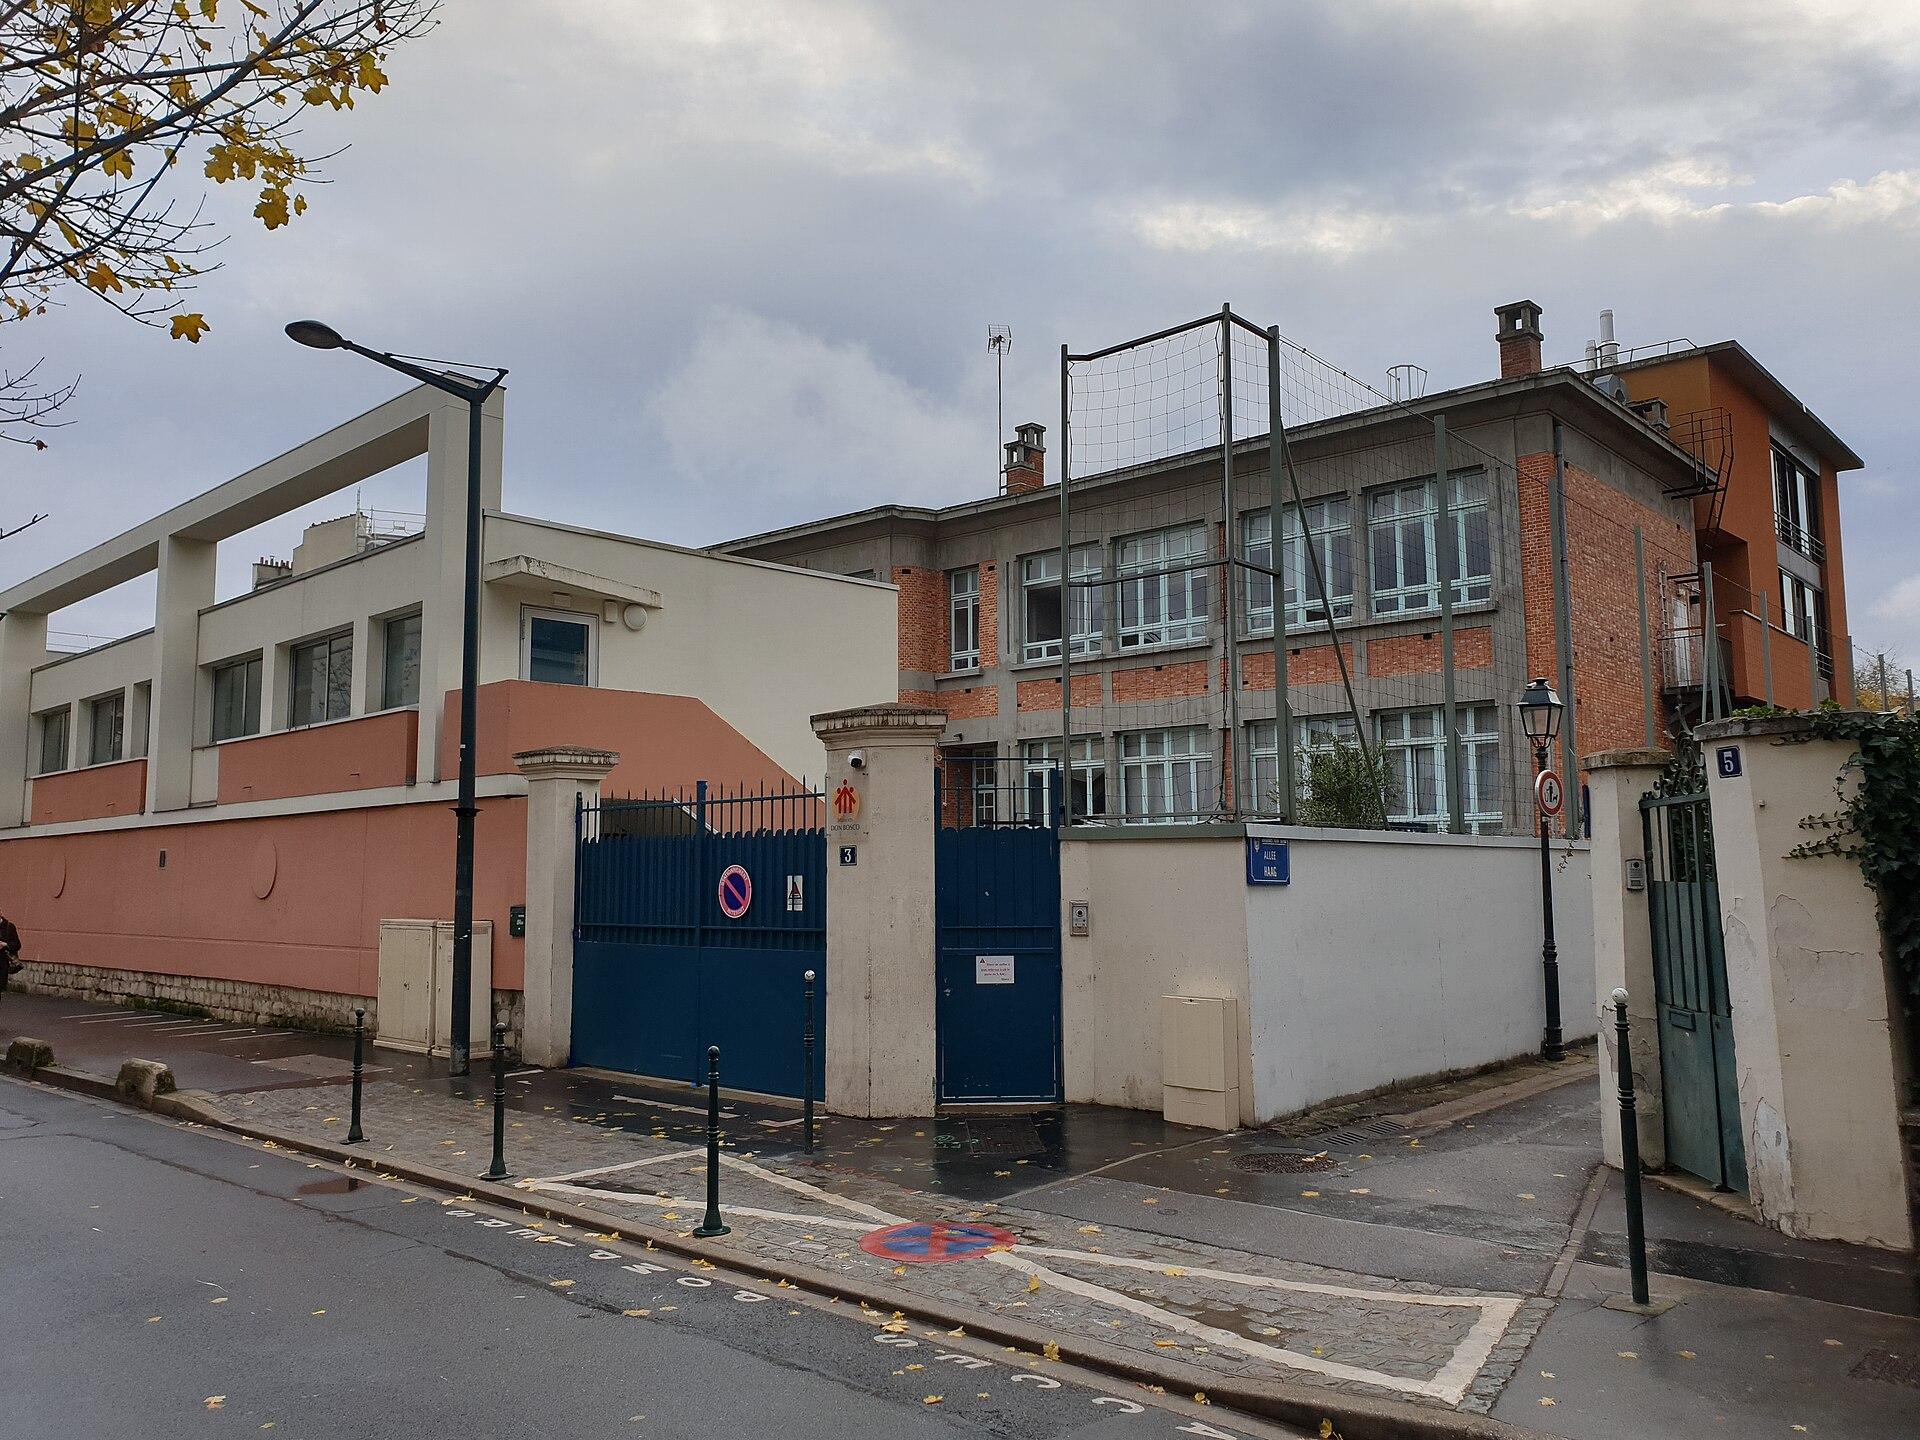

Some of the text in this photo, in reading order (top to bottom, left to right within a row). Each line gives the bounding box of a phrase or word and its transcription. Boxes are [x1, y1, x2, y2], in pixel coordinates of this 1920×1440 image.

[1723, 751, 1734, 773] 5
[844, 848, 852, 863] 3
[445, 1209, 770, 1303] POMPIERS
